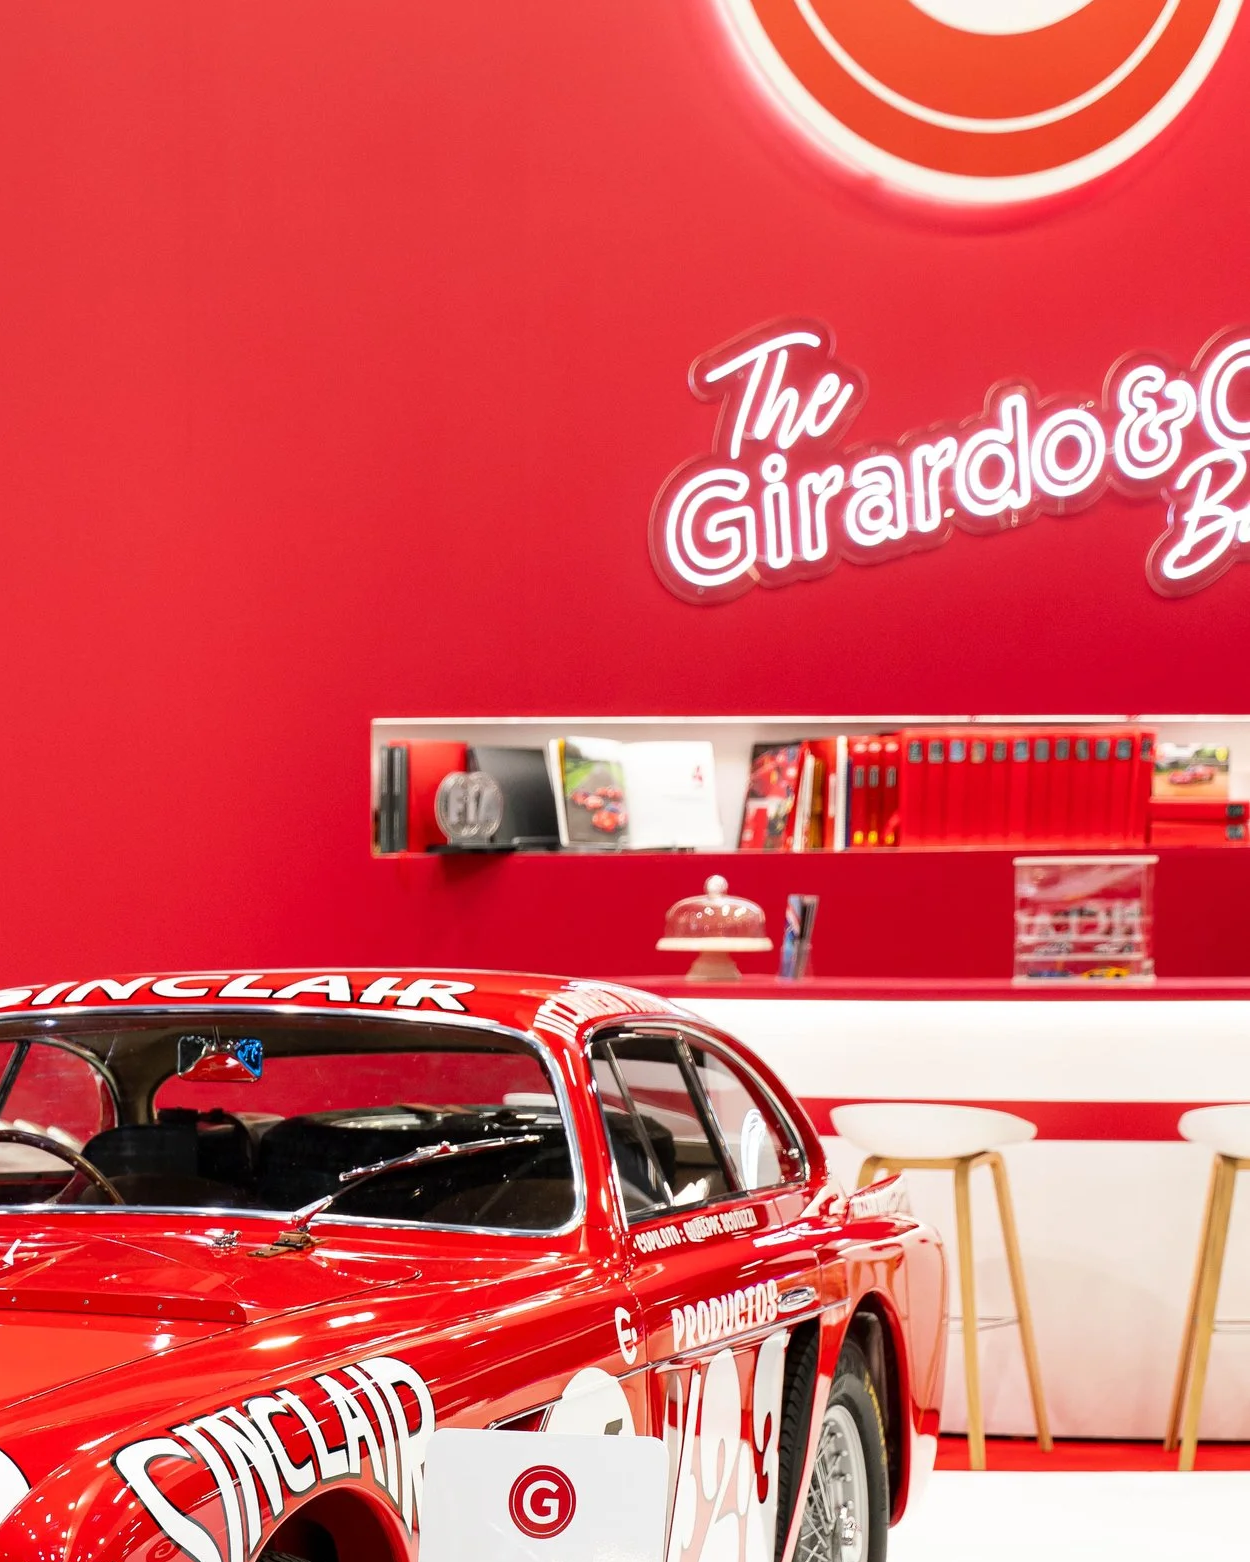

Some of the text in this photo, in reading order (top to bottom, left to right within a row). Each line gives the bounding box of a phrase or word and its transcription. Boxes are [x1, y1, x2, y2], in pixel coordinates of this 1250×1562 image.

[706, 331, 853, 459] The
[671, 1279, 779, 1353] PRODUCTOS
[522, 1479, 560, 1525] G
